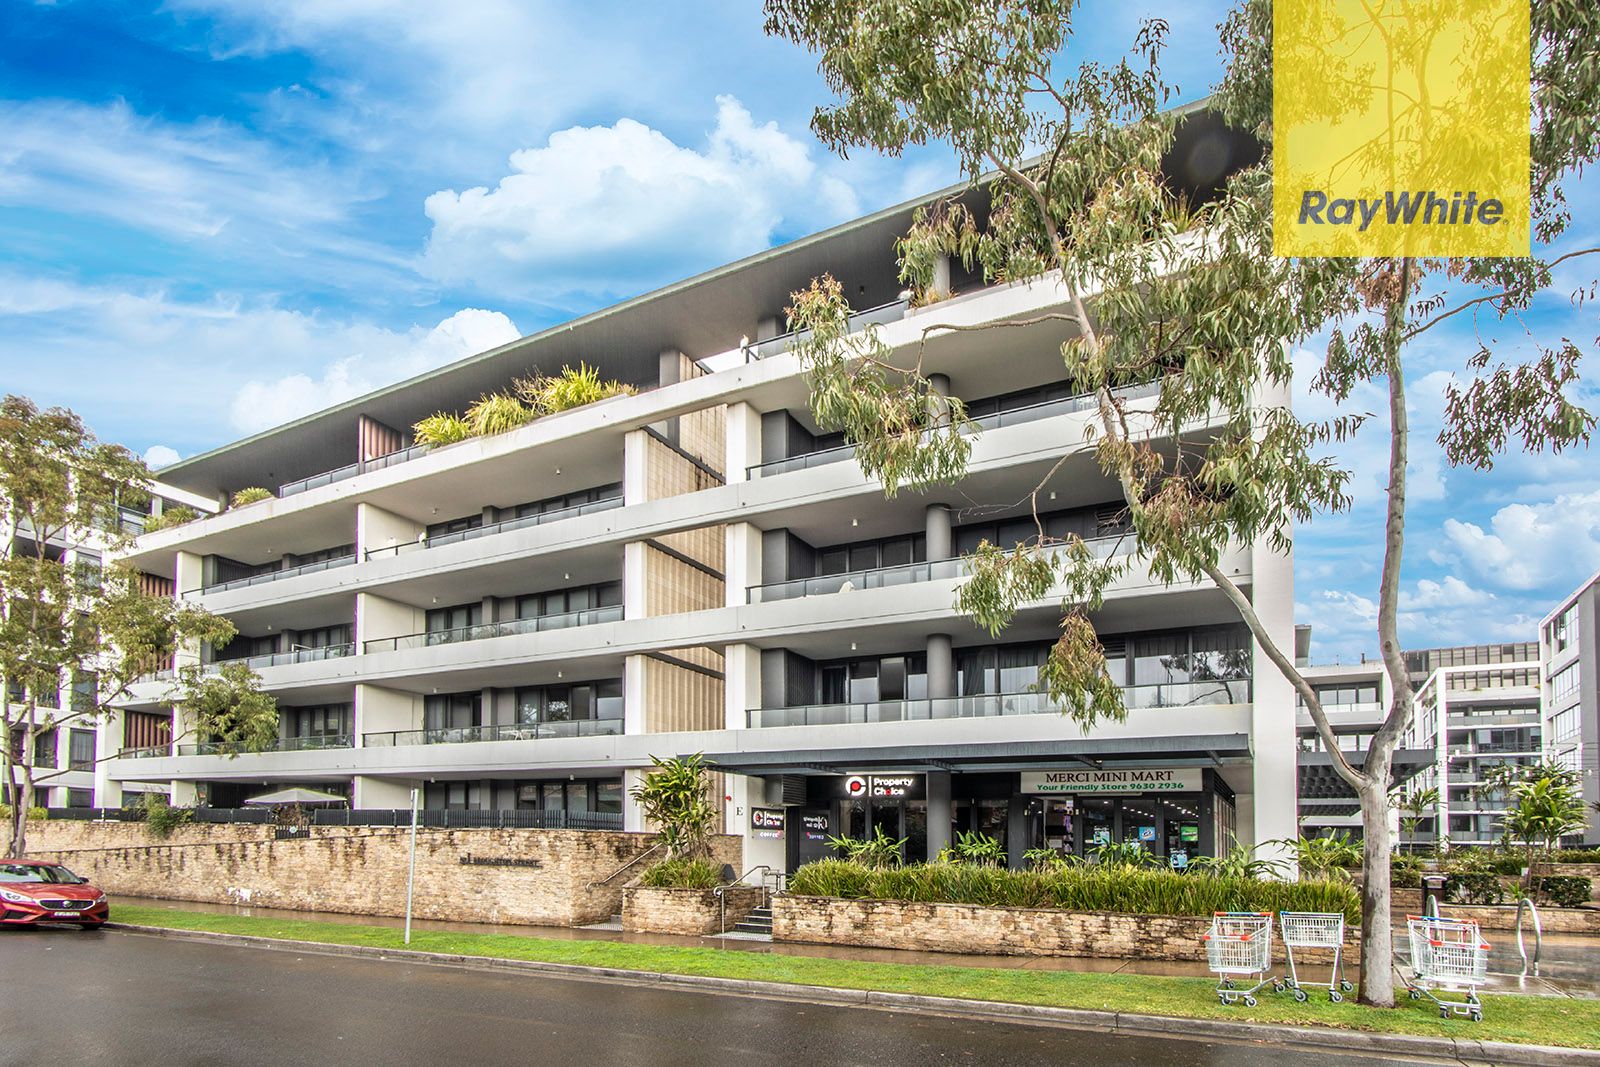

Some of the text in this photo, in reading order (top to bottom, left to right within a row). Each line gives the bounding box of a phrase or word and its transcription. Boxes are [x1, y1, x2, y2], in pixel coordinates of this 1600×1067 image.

[1046, 770, 1174, 783] MERCI MINI MART
[873, 777, 914, 787] Property
[1060, 783, 1101, 792] Friendly
[1129, 782, 1156, 790] 9630
[1158, 782, 1184, 790] 2936
[873, 787, 905, 796] Choice
[736, 806, 744, 816] E
